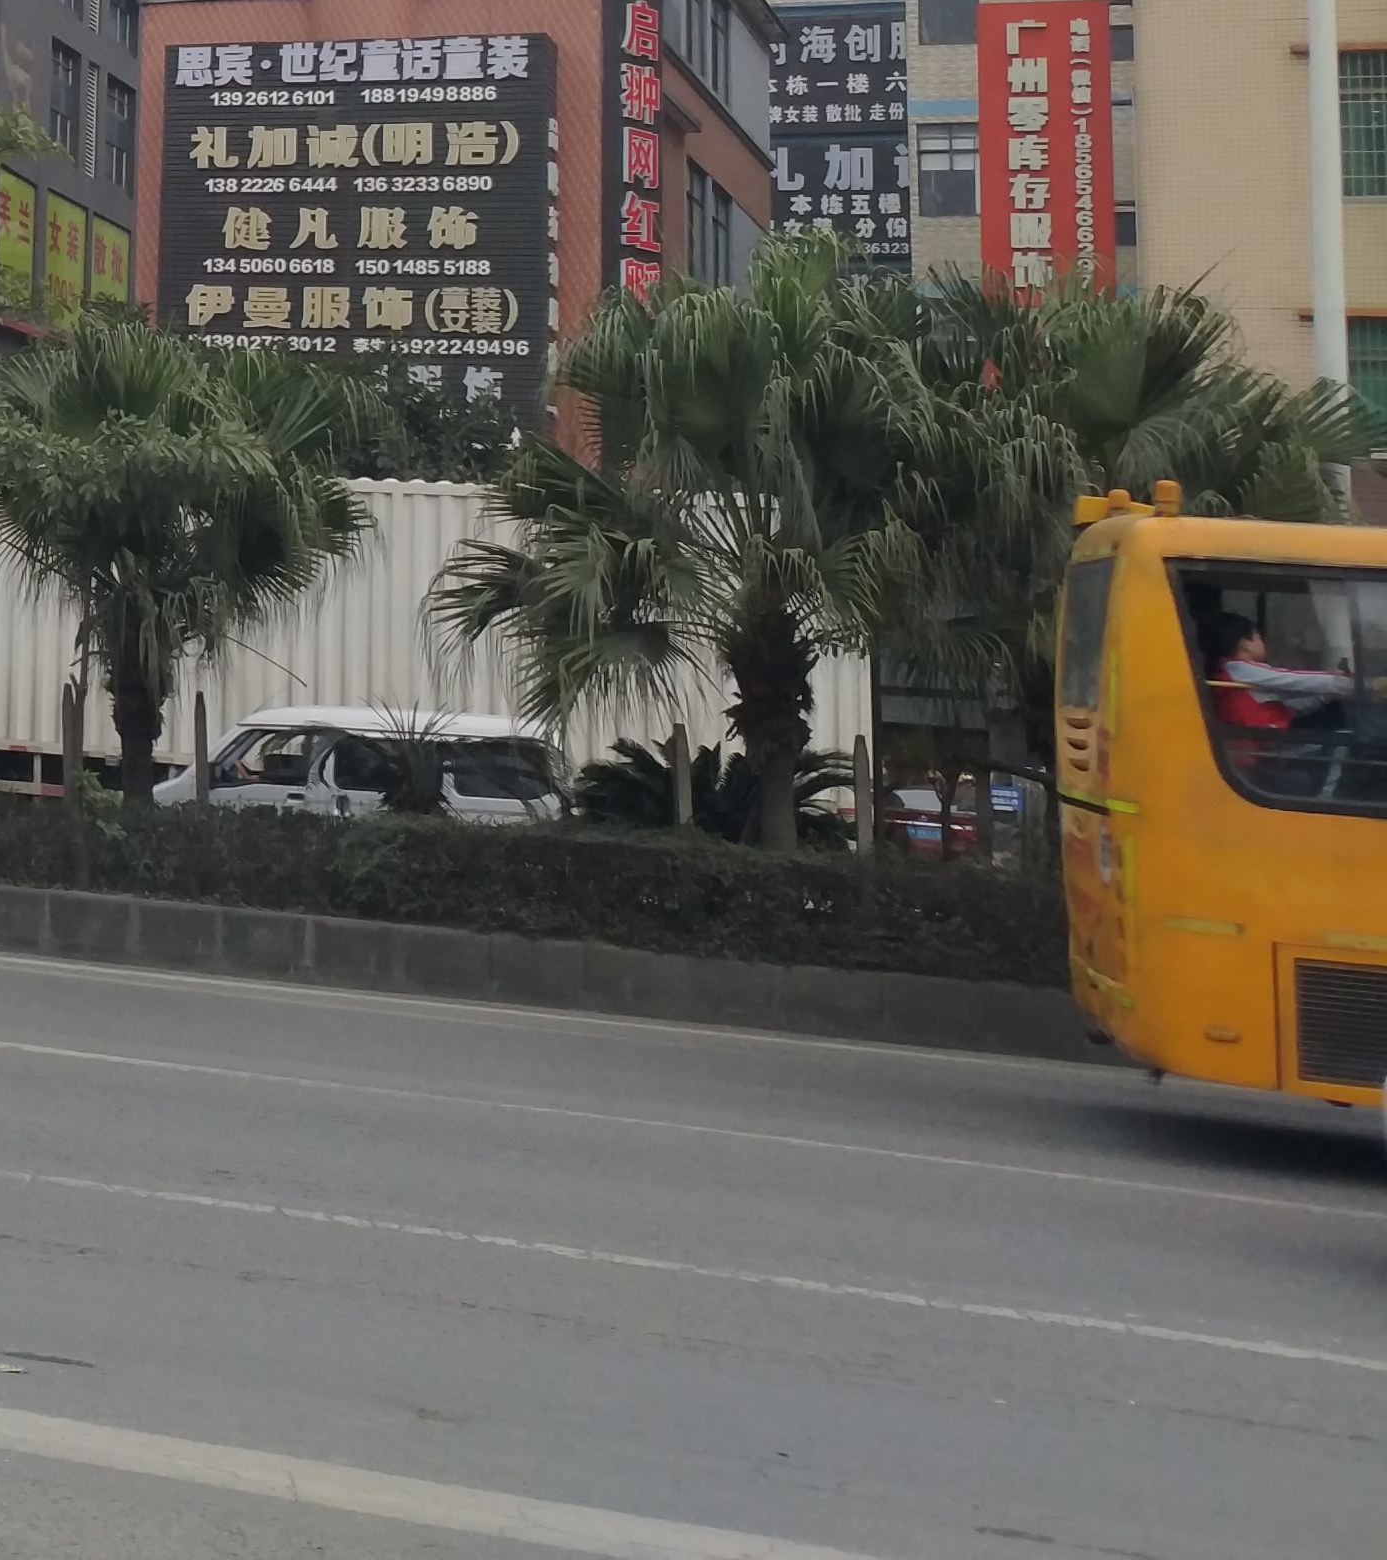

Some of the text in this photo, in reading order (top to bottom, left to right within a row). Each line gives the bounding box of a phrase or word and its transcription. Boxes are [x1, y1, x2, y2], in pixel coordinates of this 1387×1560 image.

[1006, 20, 1054, 289] 广州零库存服饰
[222, 205, 479, 251] 健凡服饰
[184, 283, 415, 331] 伊曼服饰
